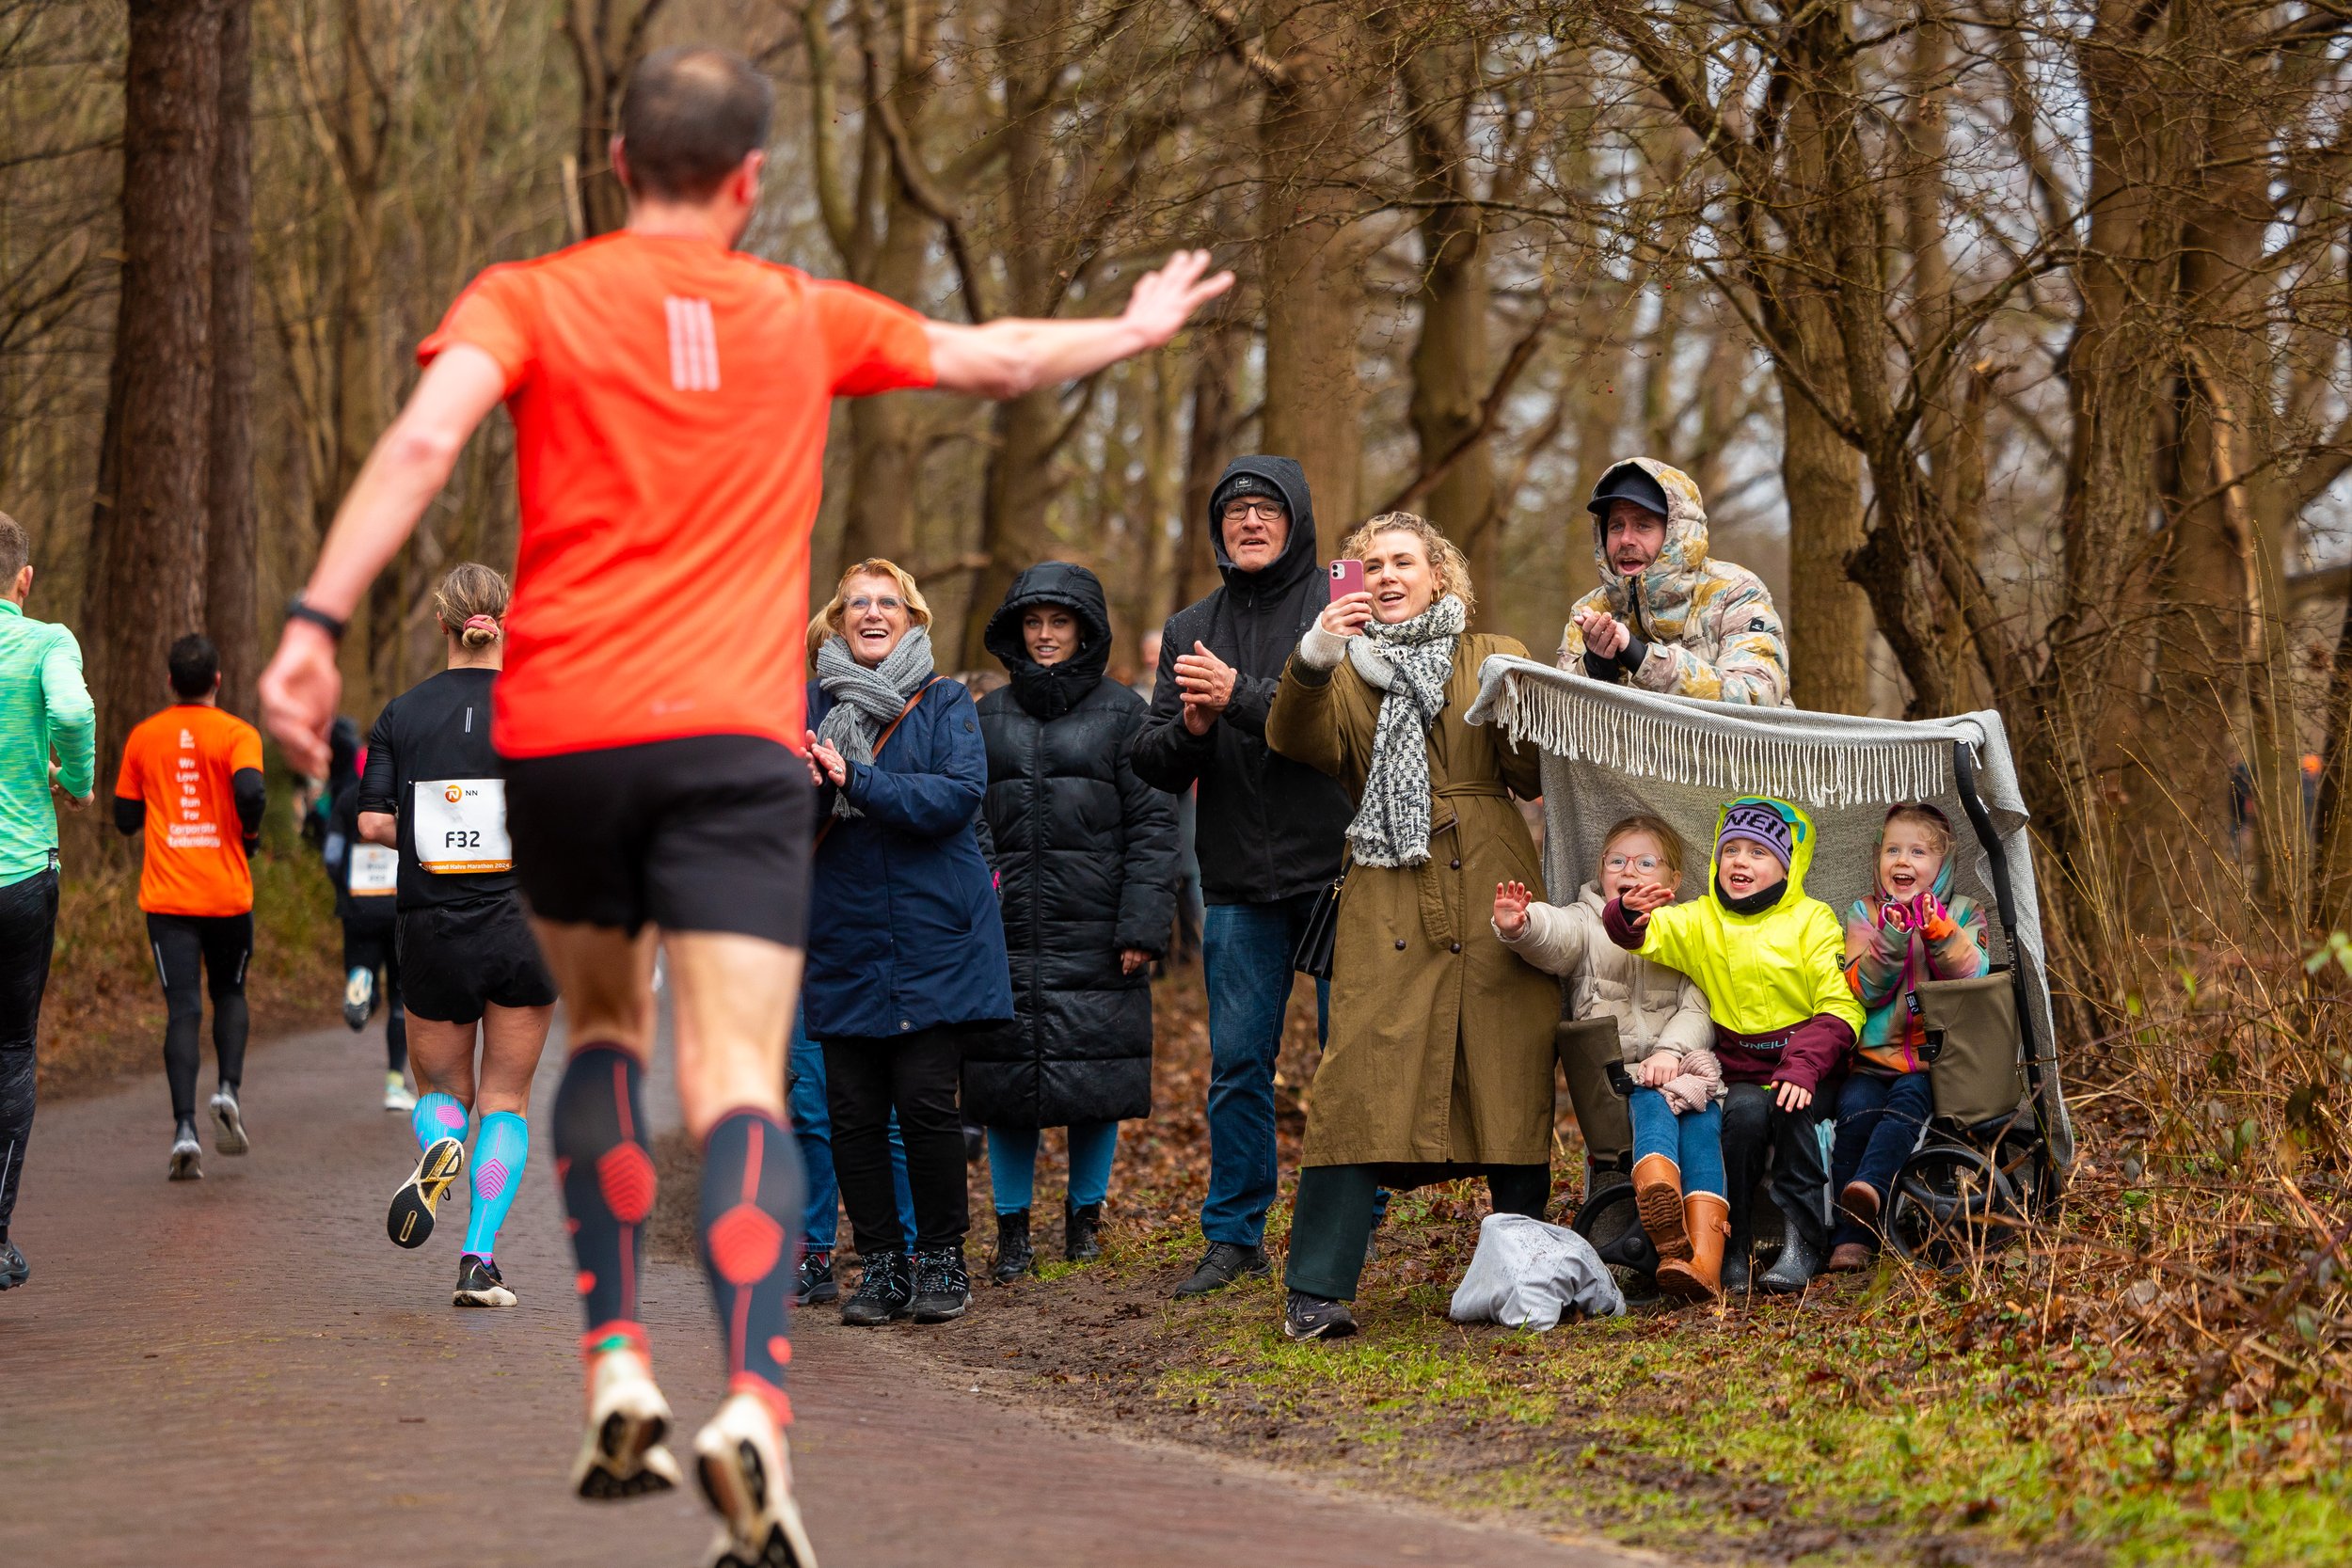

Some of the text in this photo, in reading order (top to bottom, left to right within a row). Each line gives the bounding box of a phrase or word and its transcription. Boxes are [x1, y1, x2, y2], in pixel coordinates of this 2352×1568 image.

[178, 757, 195, 768] We
[176, 771, 199, 783] Love
[183, 784, 196, 795] To
[180, 797, 201, 808] Run
[183, 809, 199, 820] For
[168, 821, 217, 835] Corporate
[167, 834, 221, 848] Technology
[445, 831, 481, 848] F32
